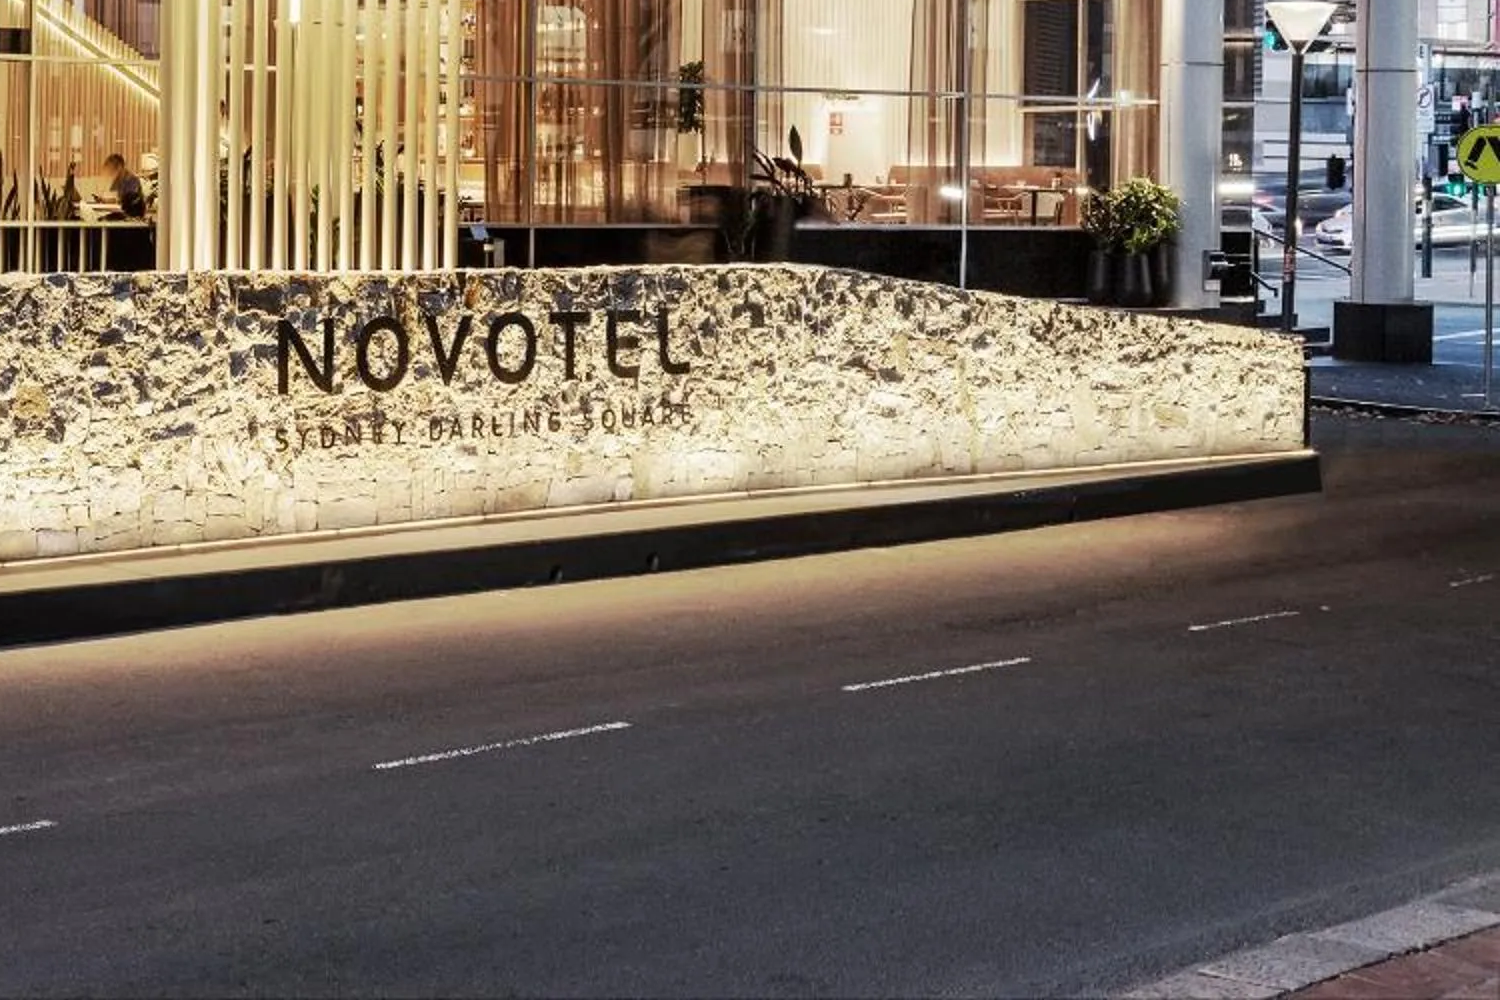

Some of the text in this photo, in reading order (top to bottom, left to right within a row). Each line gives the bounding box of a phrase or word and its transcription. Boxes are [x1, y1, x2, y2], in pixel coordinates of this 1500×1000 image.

[277, 308, 690, 394] NOVOTEL
[275, 405, 692, 452] SYDNEY DARLING SQUARE
